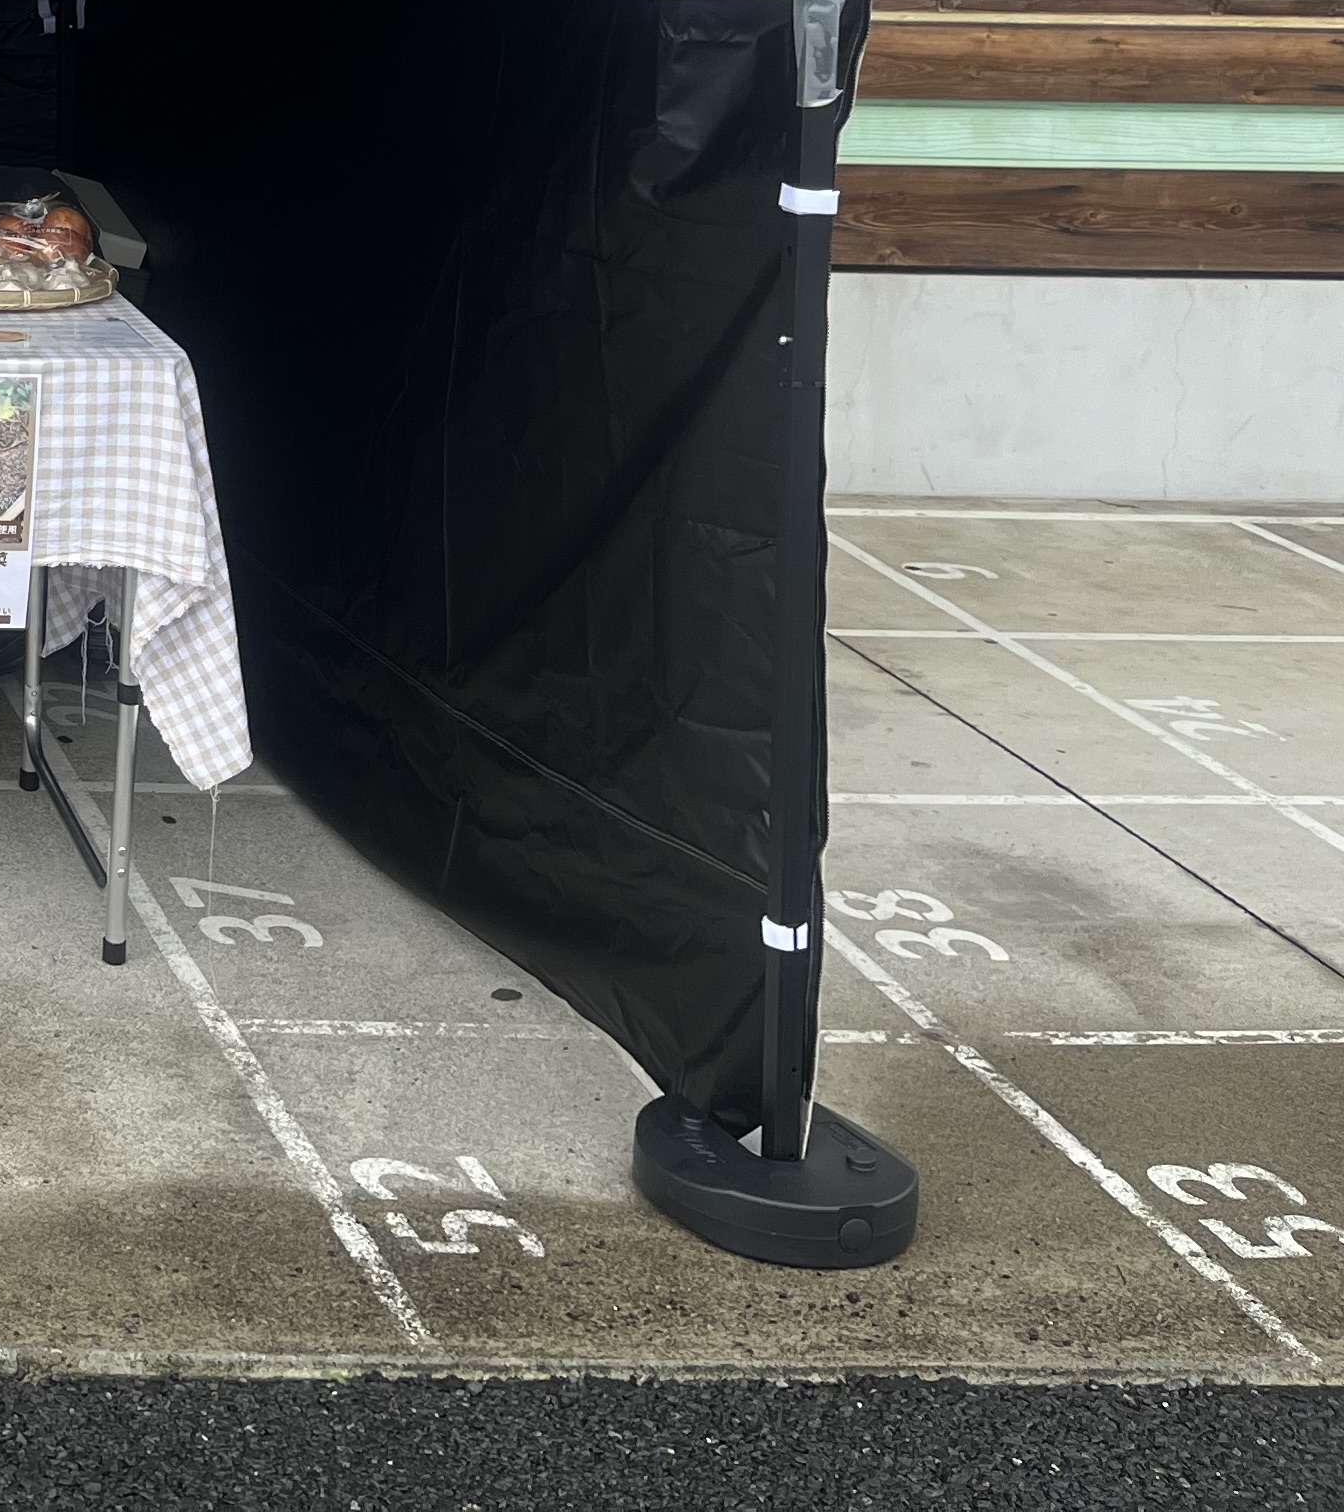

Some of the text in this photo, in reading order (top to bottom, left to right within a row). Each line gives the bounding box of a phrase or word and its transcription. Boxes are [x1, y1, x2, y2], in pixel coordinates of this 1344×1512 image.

[169, 876, 324, 948] 37
[827, 888, 1011, 963] 38
[349, 1155, 545, 1258] 52
[1146, 1162, 1344, 1259] 53
